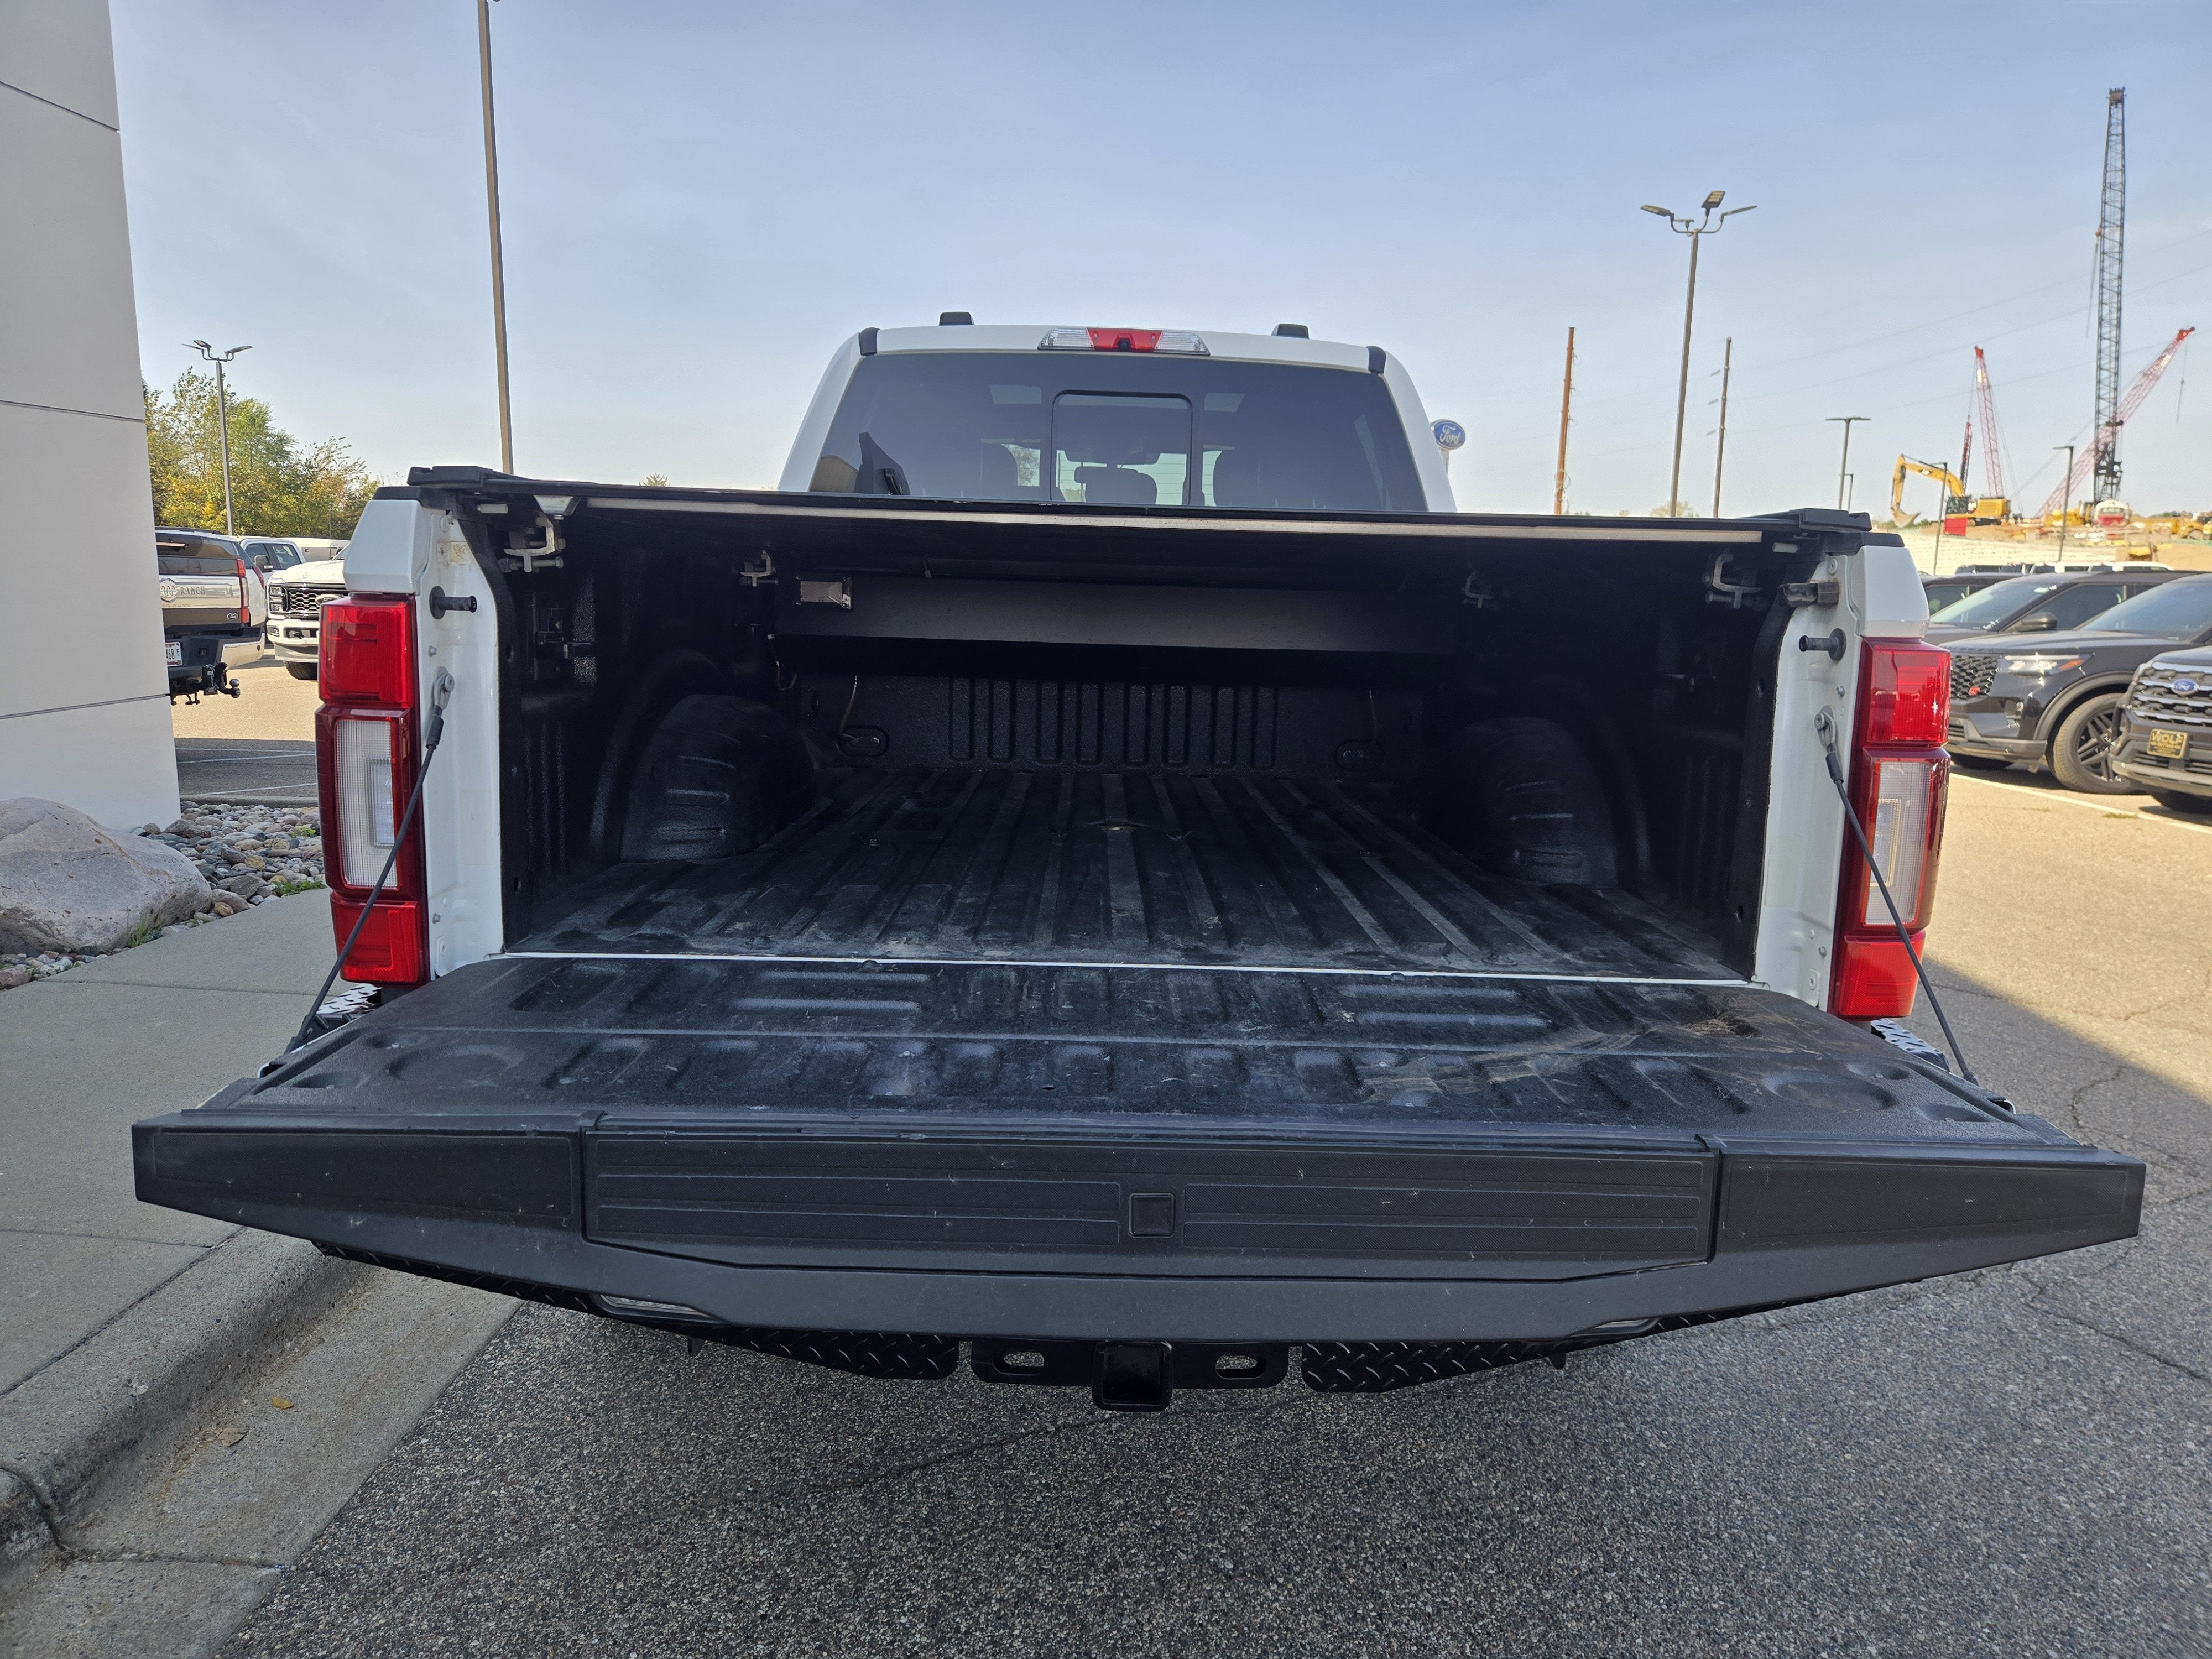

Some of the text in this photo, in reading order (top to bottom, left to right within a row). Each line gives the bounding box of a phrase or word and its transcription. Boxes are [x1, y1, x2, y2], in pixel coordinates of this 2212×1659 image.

[1440, 425, 1461, 445] Ford
[180, 586, 206, 595] RANCH
[2151, 731, 2183, 744] WOLF
